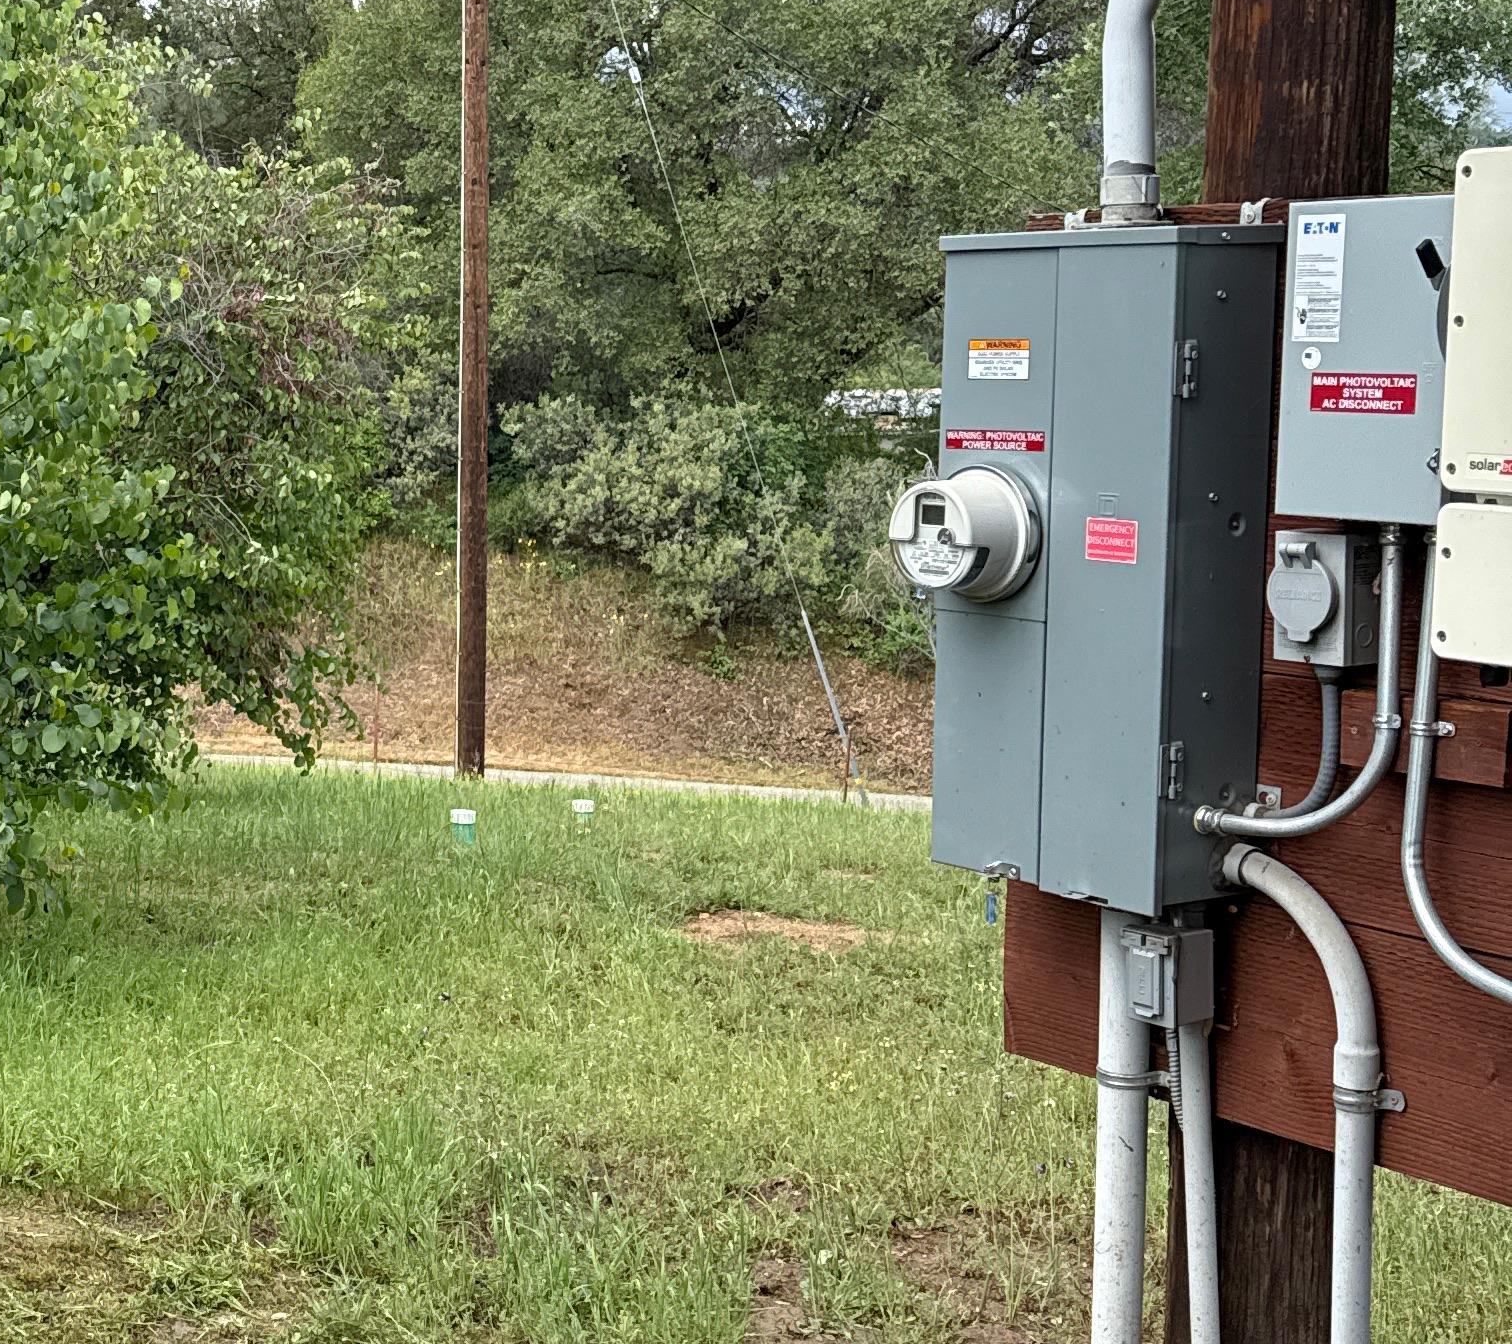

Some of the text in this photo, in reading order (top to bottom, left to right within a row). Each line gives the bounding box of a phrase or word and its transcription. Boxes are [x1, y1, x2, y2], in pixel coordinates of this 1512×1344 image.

[1313, 376, 1416, 387] MAIN PHOTOVOLTAIC
[1343, 388, 1383, 398] SYSTEM
[1322, 399, 1403, 410] AC DISCONNECT
[986, 431, 1044, 441] PHOTOVOLTAIC
[962, 441, 1027, 450] POWER SOURCE
[1089, 523, 1134, 534] EMERGENCY
[1088, 536, 1134, 547] DISCONNECT
